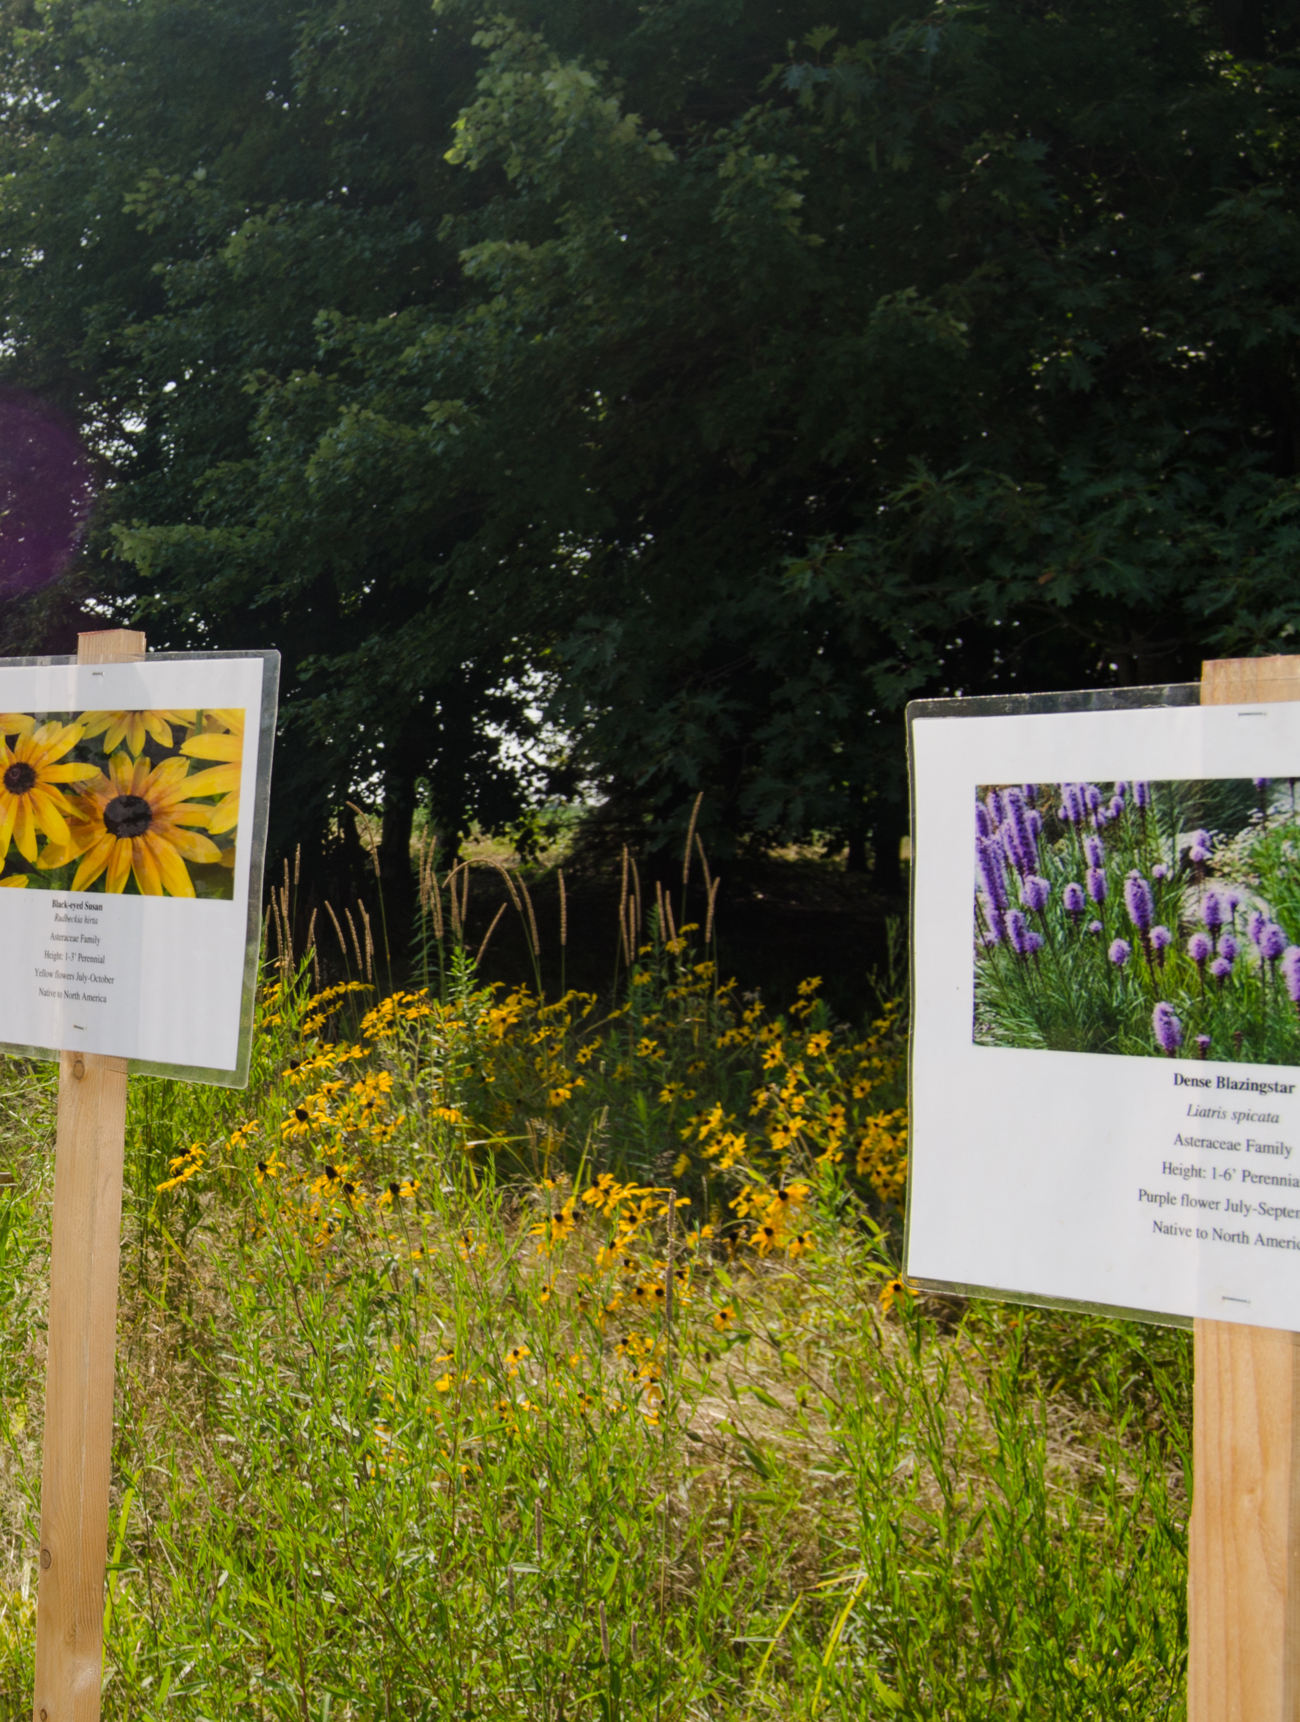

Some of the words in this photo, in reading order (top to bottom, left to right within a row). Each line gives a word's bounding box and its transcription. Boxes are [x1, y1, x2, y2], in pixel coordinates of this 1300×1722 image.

[52, 899, 83, 911] Black-eyed
[85, 902, 103, 911] Susan
[54, 913, 82, 924] Rudbeckia
[84, 916, 98, 925] hirta
[50, 932, 79, 943] Asteraceae
[80, 934, 101, 946] Family
[44, 950, 63, 962] Height:
[78, 953, 105, 964] Perennial
[35, 968, 53, 978] Yellow
[55, 970, 74, 980] flowers
[76, 972, 114, 984] July-October
[39, 988, 56, 998] Native
[64, 991, 80, 1000] North
[82, 993, 106, 1003] America
[1173, 1073, 1211, 1088] Dense
[1216, 1076, 1296, 1095] Blazingstar
[1187, 1104, 1227, 1120] Liatris
[1231, 1109, 1279, 1124] spicata
[1173, 1133, 1241, 1151] Asteraceae
[1246, 1139, 1292, 1159] Family
[1162, 1161, 1206, 1180] Height:
[1138, 1189, 1177, 1208] Purple
[1181, 1194, 1220, 1211] flower
[1152, 1220, 1192, 1238] Native
[1196, 1228, 1208, 1239] to
[1212, 1228, 1249, 1245] North
